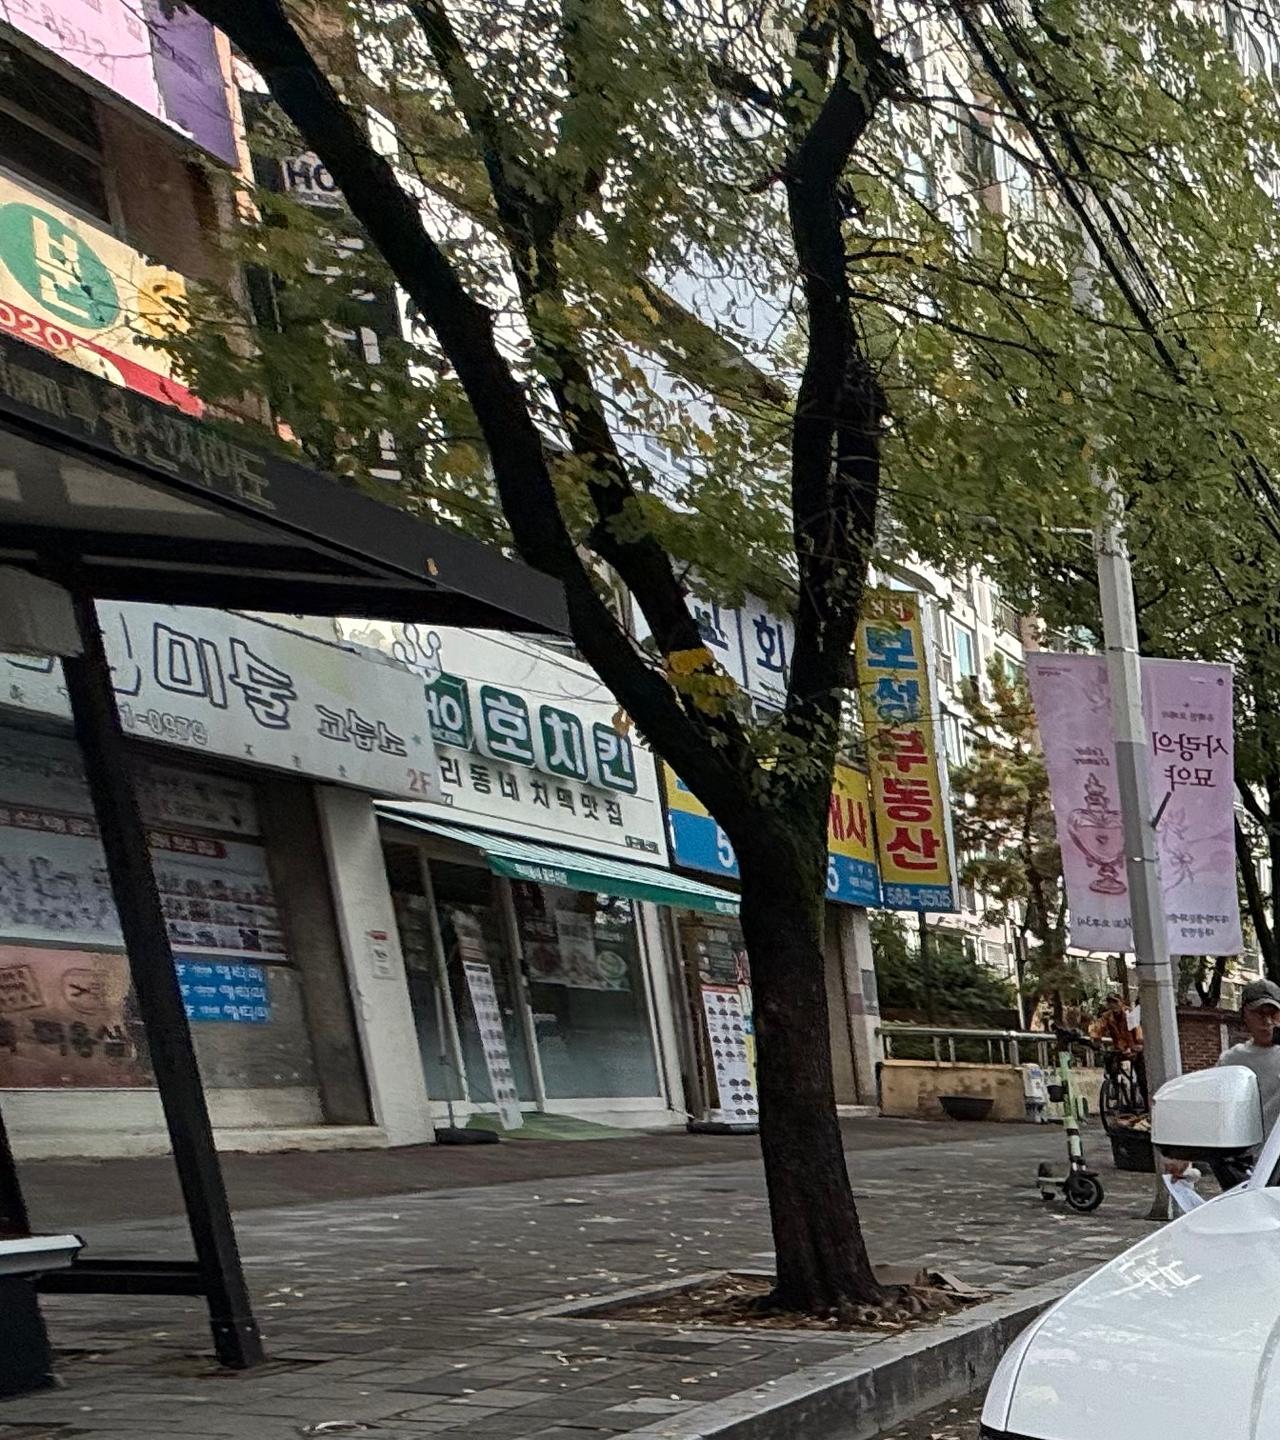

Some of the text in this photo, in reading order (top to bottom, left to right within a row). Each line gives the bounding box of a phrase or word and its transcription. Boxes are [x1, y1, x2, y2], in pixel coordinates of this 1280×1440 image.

[315, 703, 408, 757] 교습소
[485, 694, 636, 791] 호치킨
[406, 767, 432, 796] 2F
